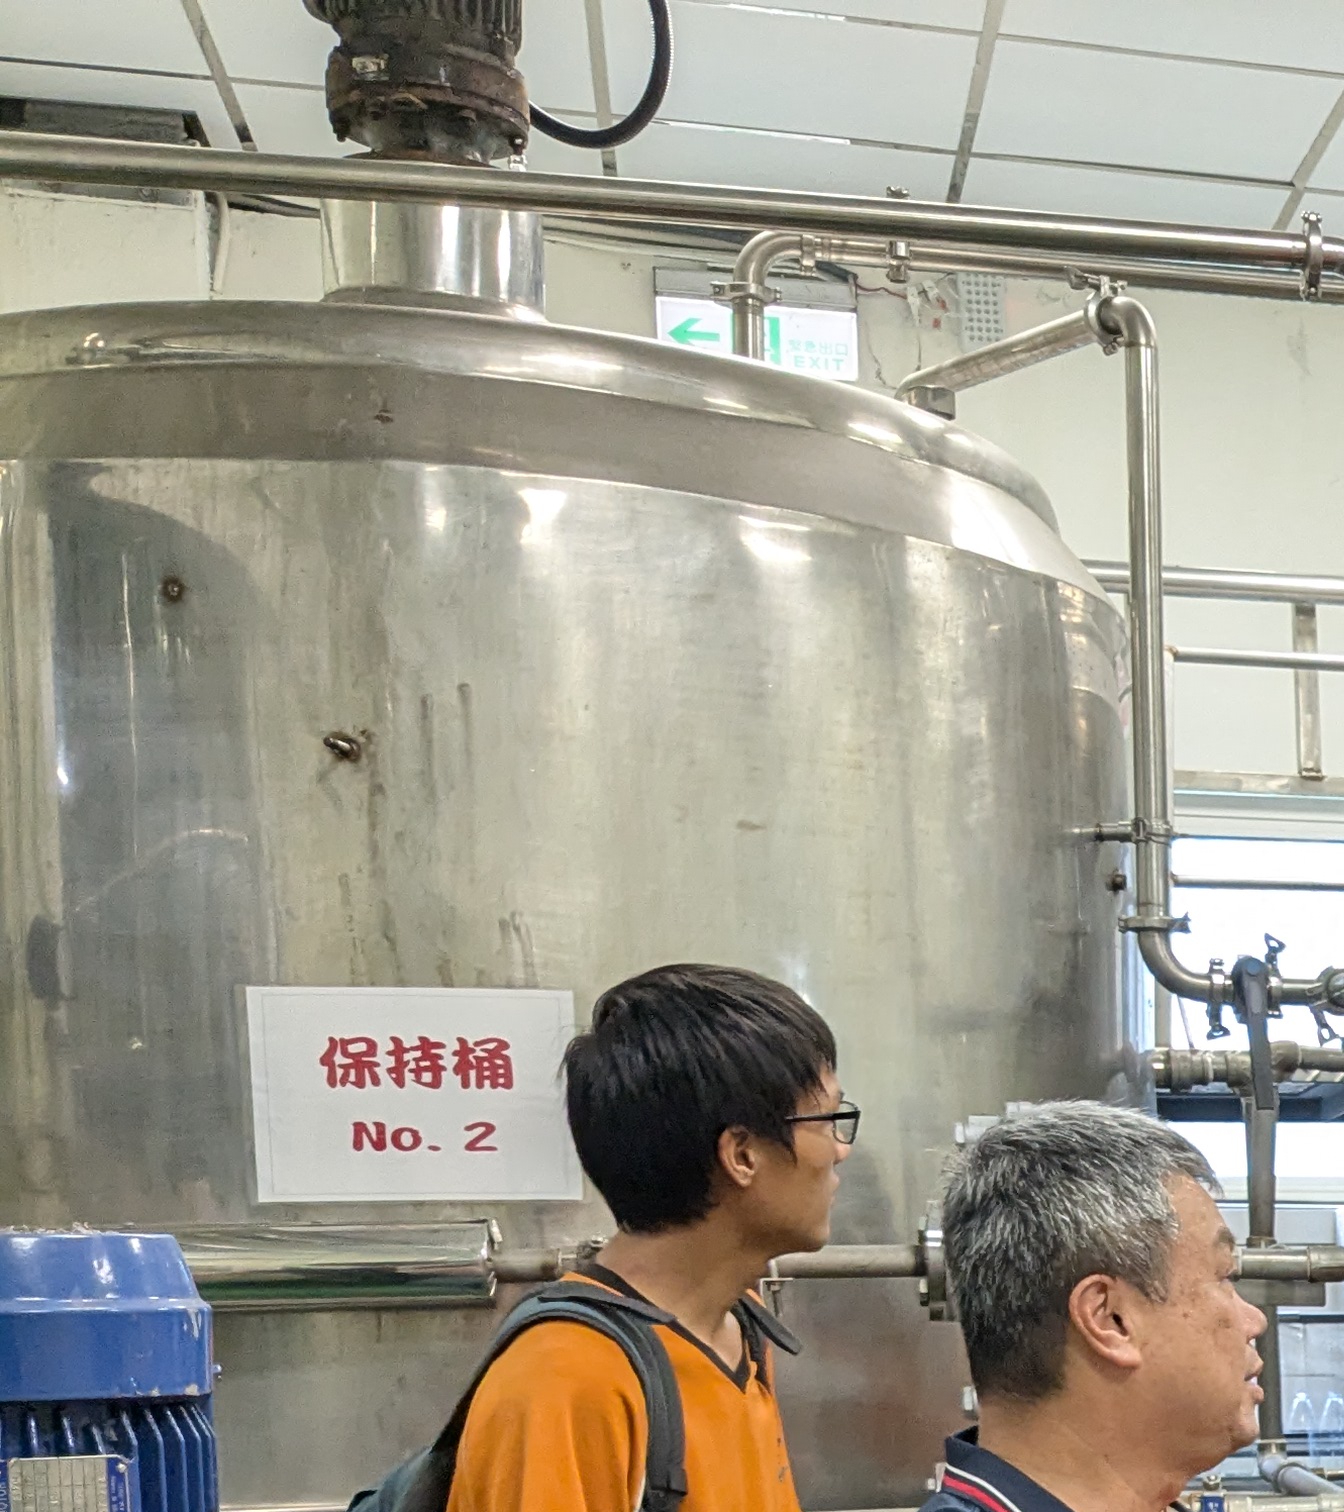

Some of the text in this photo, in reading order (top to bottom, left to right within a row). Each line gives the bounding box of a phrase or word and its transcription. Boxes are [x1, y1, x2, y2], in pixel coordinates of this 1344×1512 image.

[793, 355, 844, 371] EXIT
[319, 1036, 514, 1090] 保持桶
[352, 1121, 498, 1152] No. 2
